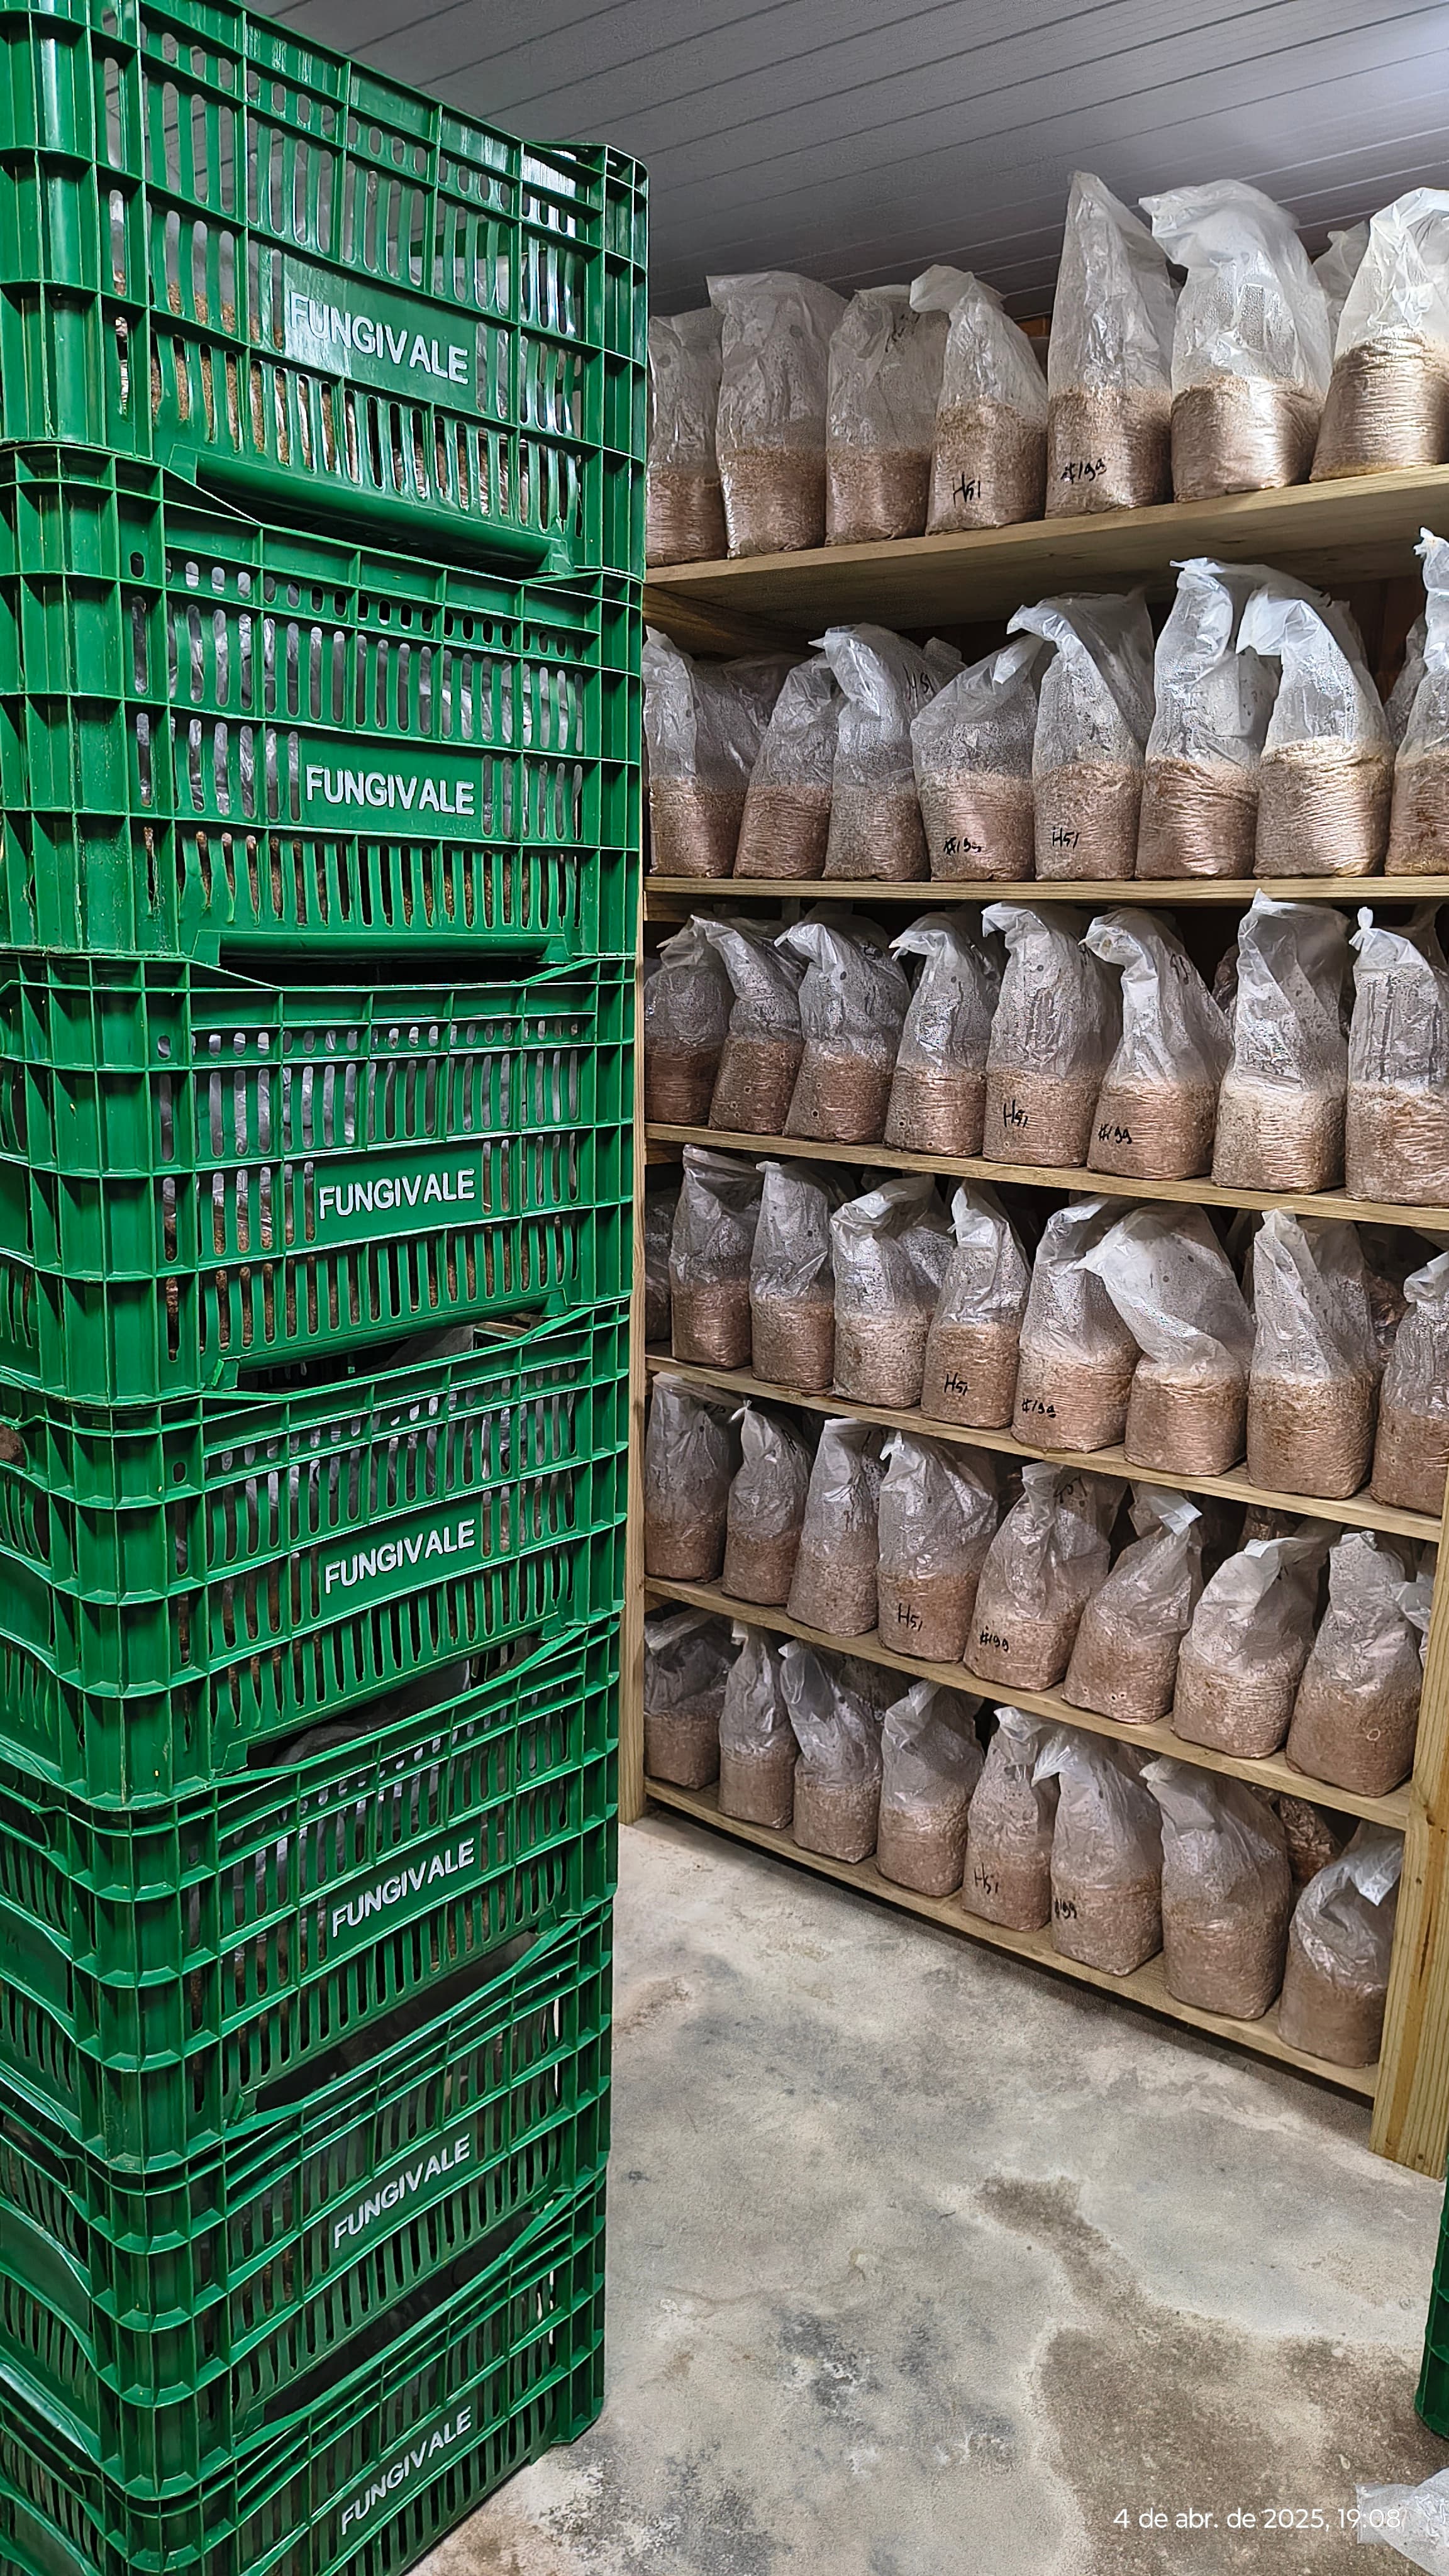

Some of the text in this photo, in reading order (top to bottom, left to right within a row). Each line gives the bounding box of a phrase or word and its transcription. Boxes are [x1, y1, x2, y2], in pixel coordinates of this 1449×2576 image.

[289, 290, 469, 386] FUNGIVALE
[306, 764, 475, 817] FUNGIVALE
[1052, 827, 1080, 850] H51
[319, 1169, 475, 1220] FUNGIVALE
[944, 1372, 968, 1396] H51
[325, 1519, 475, 1594] FUNGIVALE
[898, 1603, 923, 1631] H51
[331, 1837, 475, 1938] FUNGIVALE
[333, 2133, 472, 2250] FUNGIVALE
[340, 2406, 473, 2536] FUNGIVALE
